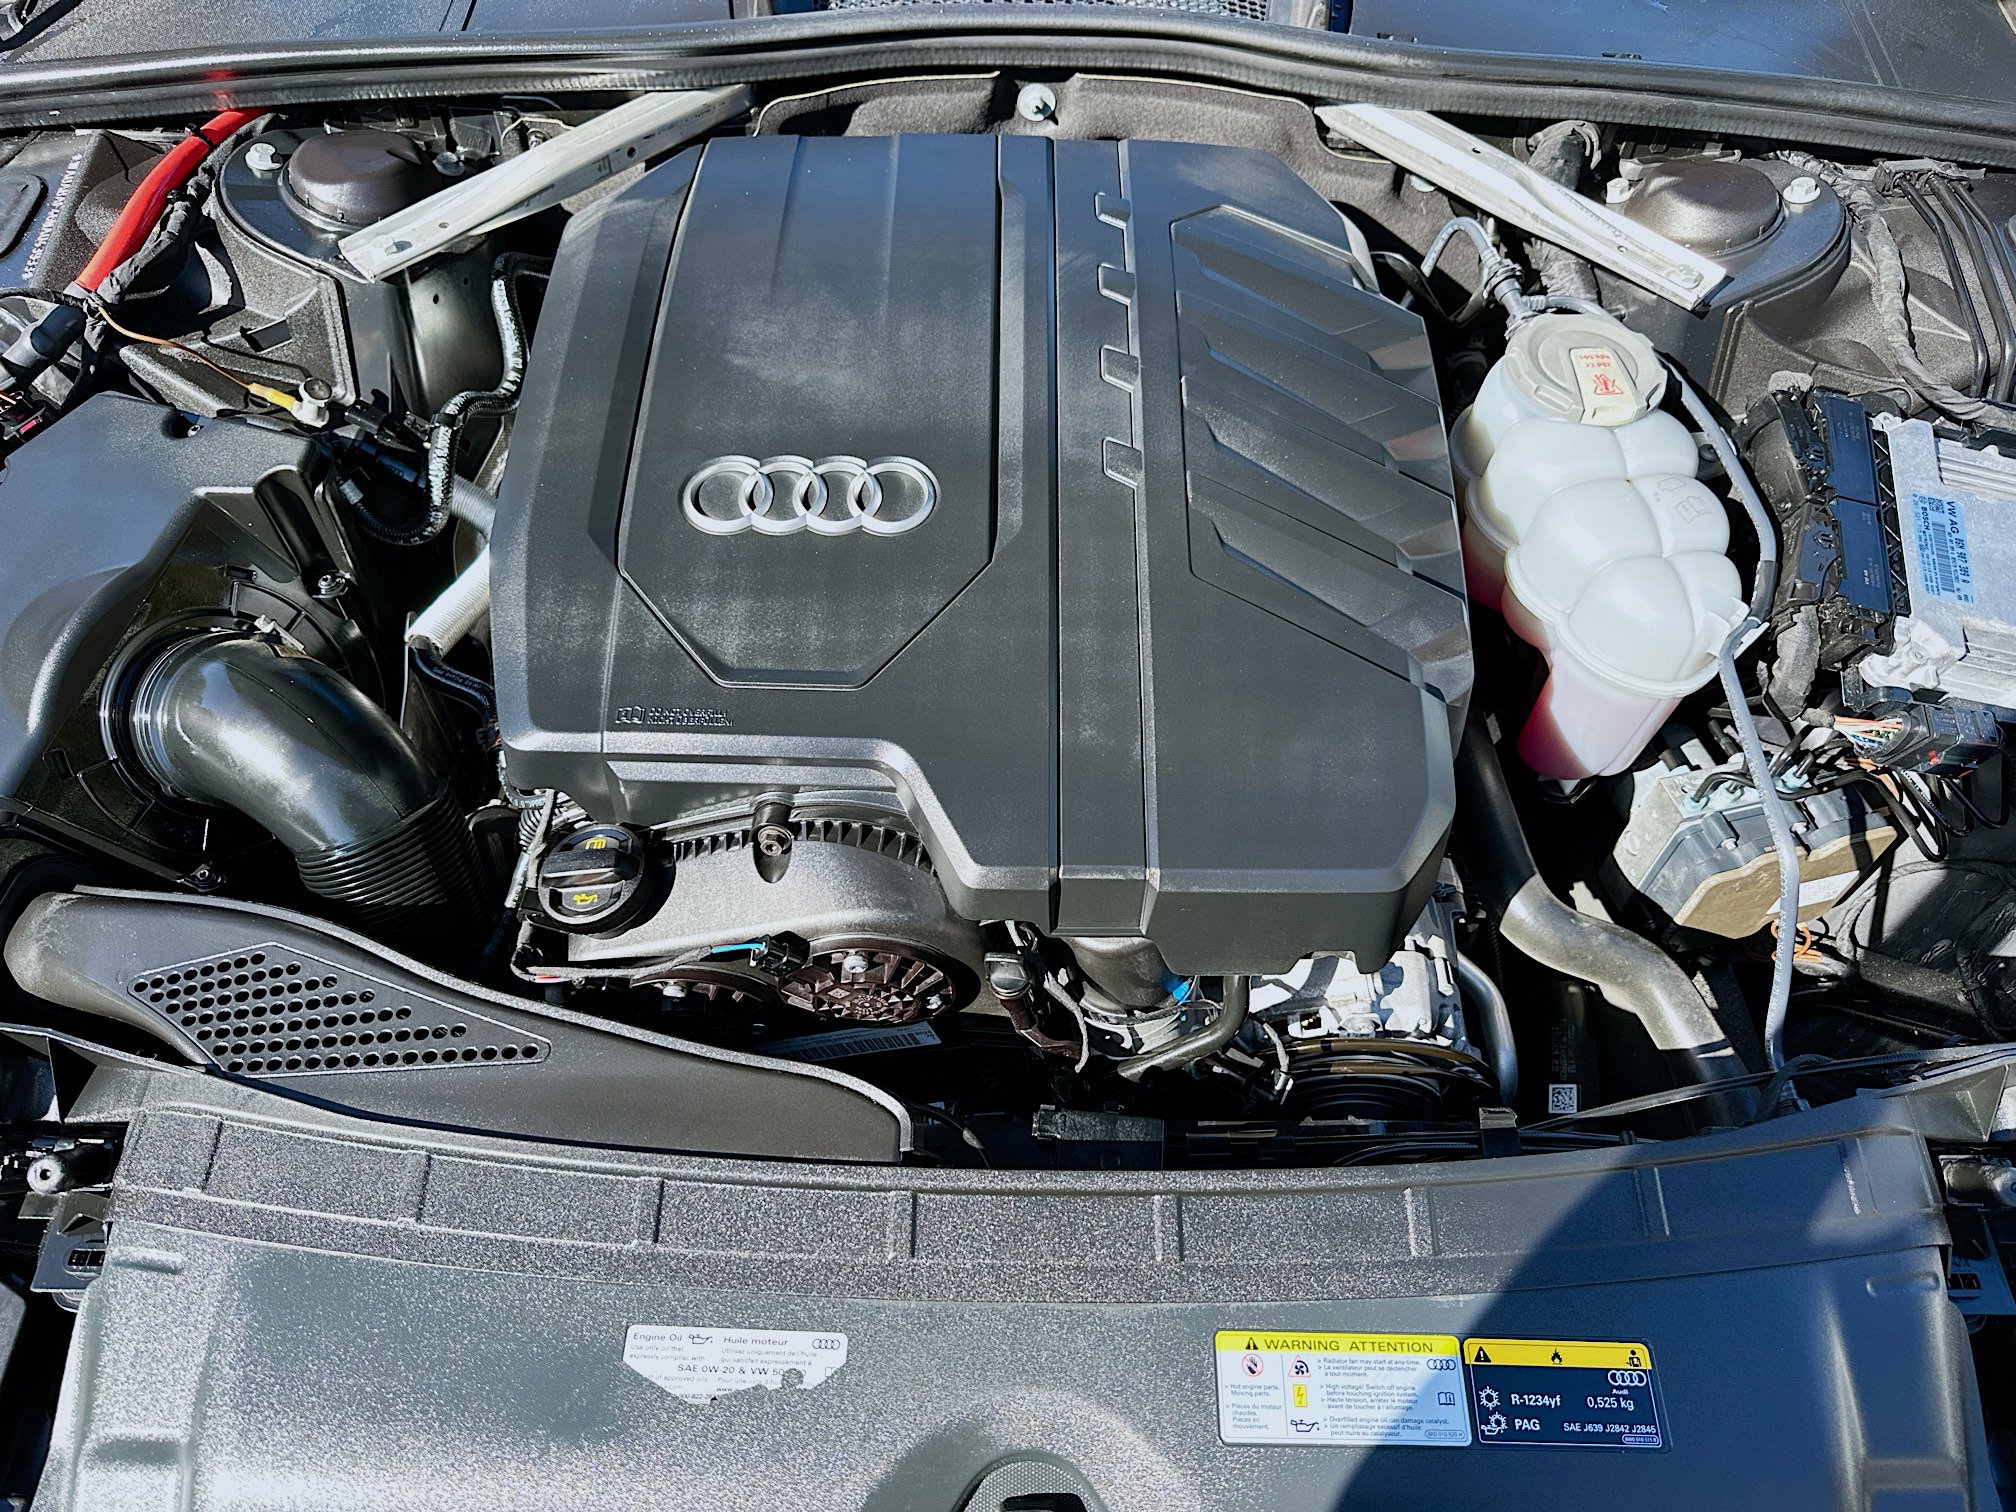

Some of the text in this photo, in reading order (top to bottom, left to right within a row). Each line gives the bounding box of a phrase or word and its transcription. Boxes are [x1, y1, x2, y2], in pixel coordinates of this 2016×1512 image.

[1945, 499, 1956, 517] VW
[1920, 505, 1930, 531] BOSCH
[1948, 518, 1959, 534] AG
[633, 1332, 683, 1342] Engine Oil
[723, 1336, 748, 1344] Huile
[1264, 1339, 1433, 1353] WARNING ATTENTION
[677, 1364, 698, 1372] SAE
[750, 1367, 769, 1375] VW
[1511, 1393, 1561, 1409] R-1234yf
[1586, 1396, 1634, 1411] 0,525 kg
[1514, 1418, 1540, 1431] PAG
[1563, 1423, 1656, 1434] SAE J639 J2842 J2845
